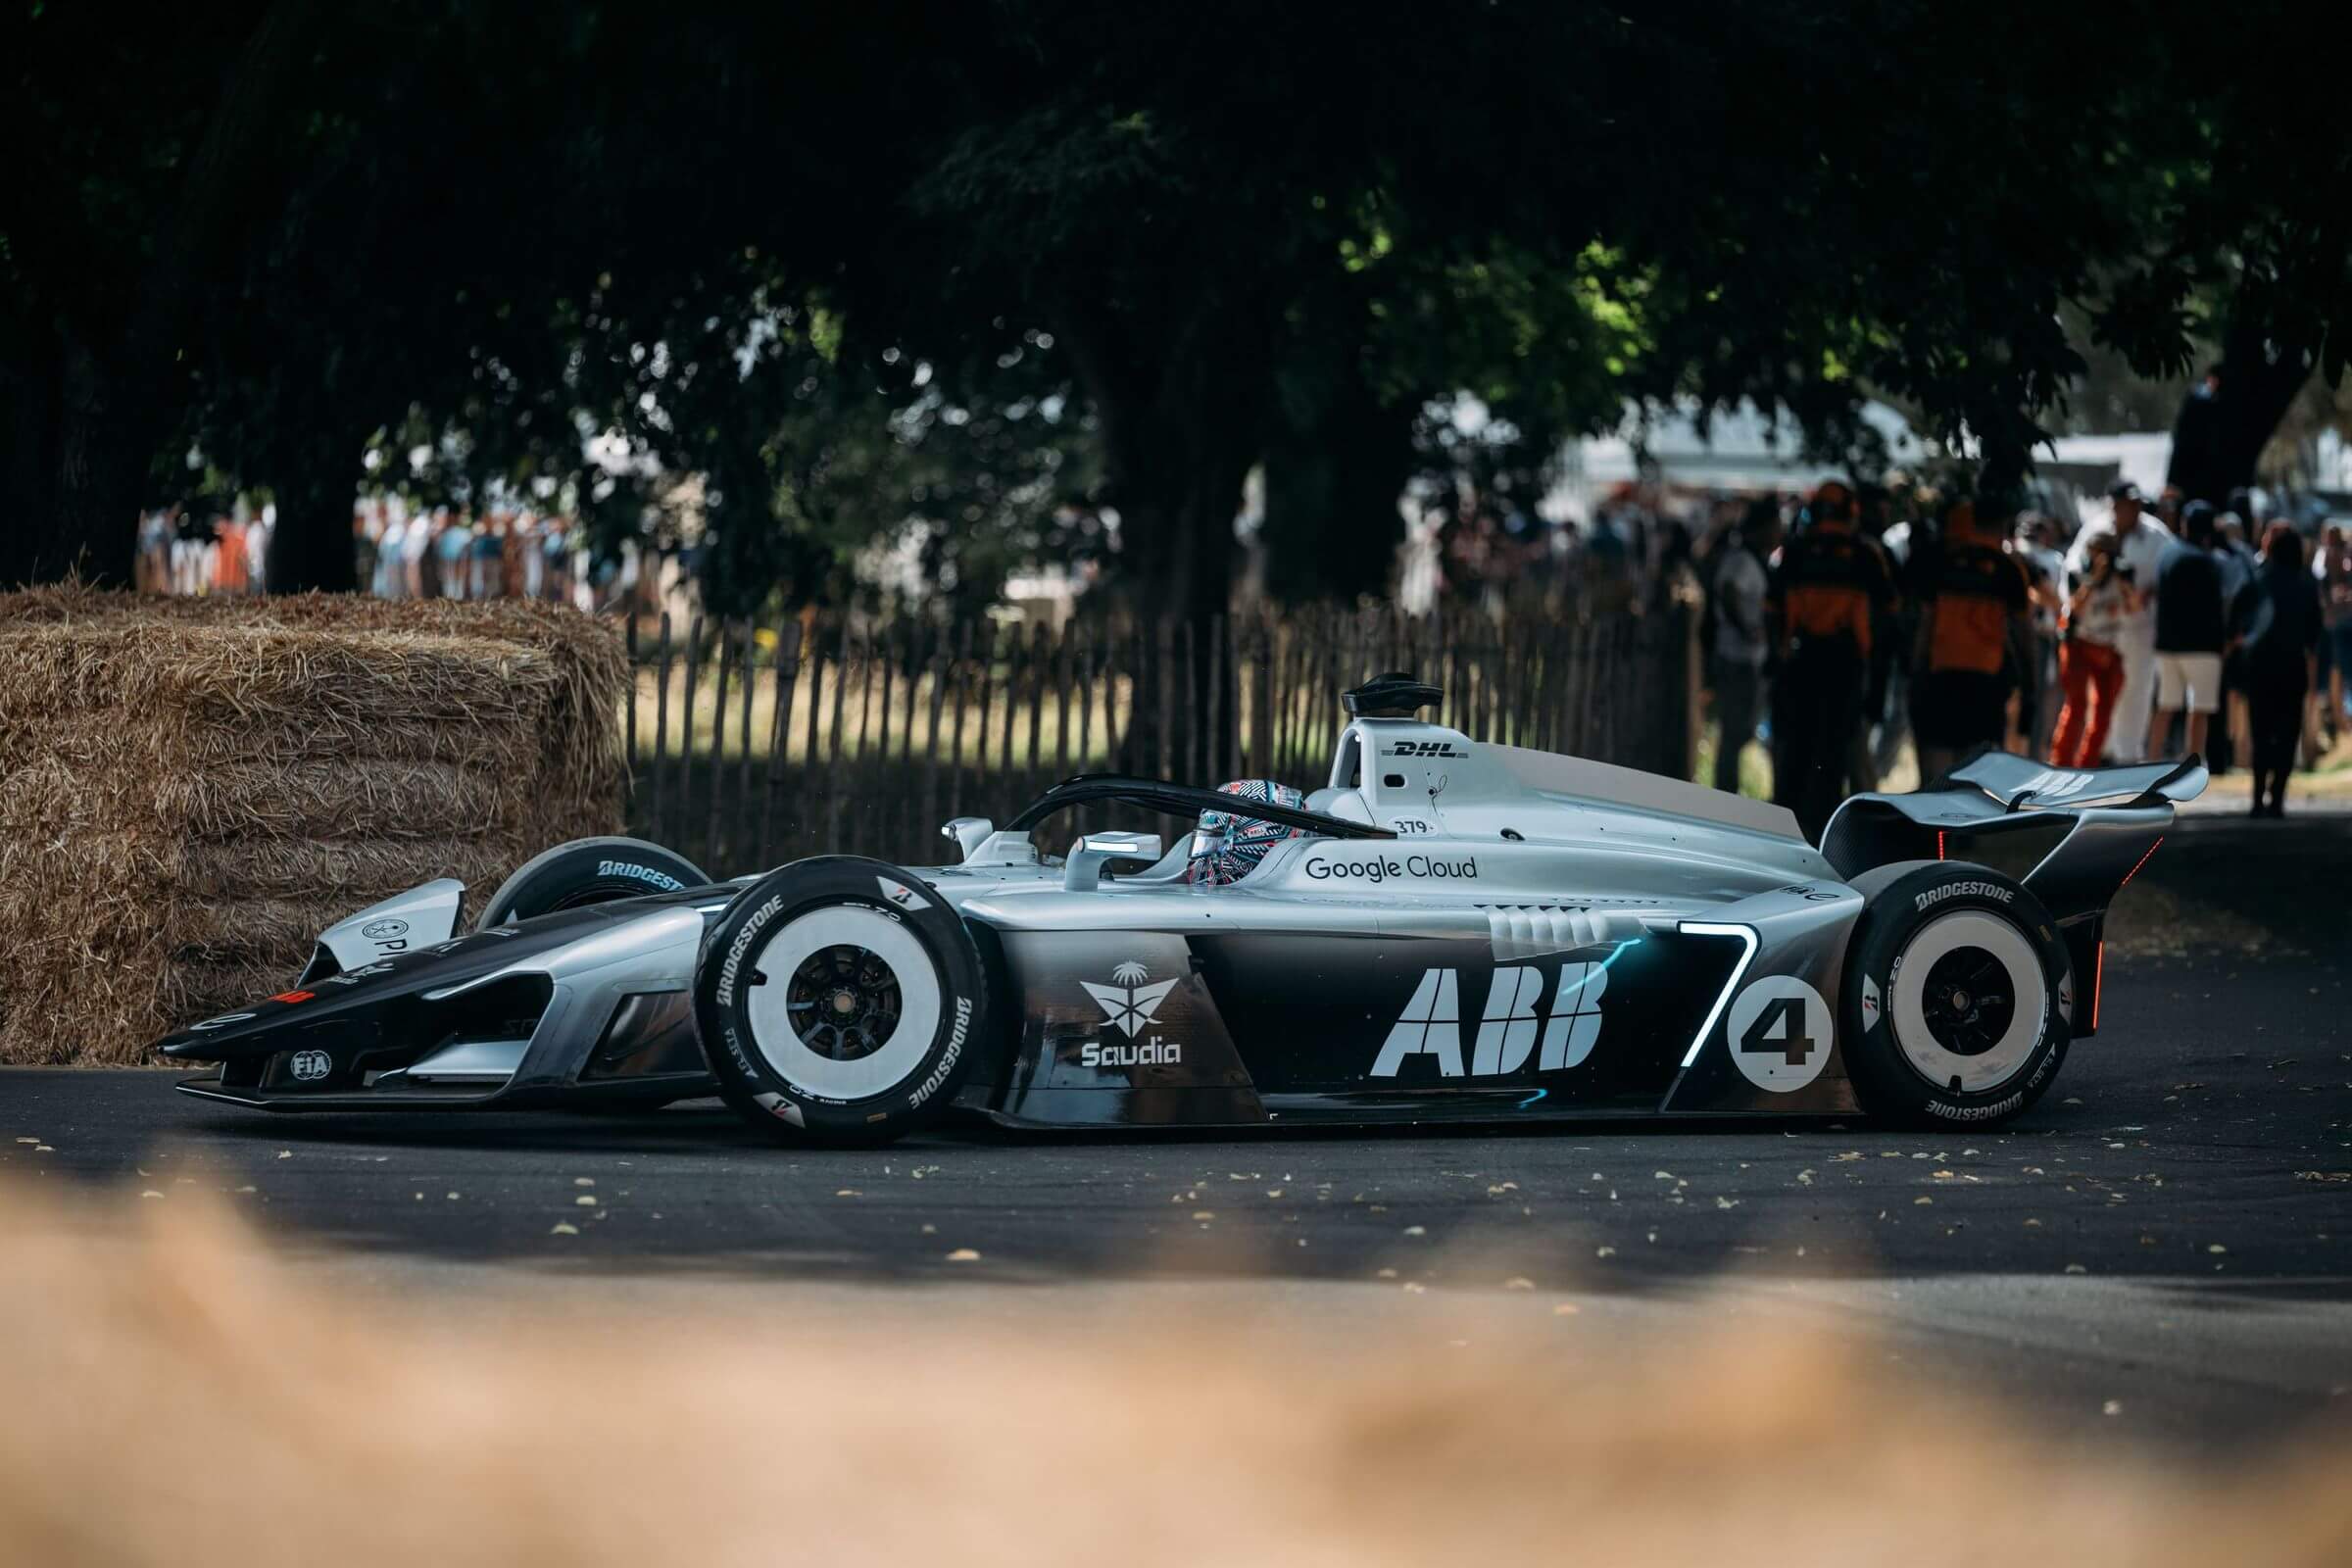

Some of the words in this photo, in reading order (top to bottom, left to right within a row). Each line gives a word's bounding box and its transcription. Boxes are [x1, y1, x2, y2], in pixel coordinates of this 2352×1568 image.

[1393, 742, 1457, 758] DHL
[1395, 821, 1428, 833] 379
[1306, 855, 1401, 883] Google
[1407, 856, 1478, 878] Cloud
[1915, 881, 2015, 911] BRIDGESTONE
[716, 894, 783, 1007] BRIDGESTONE
[1370, 961, 1609, 1077] ABB
[1740, 998, 1815, 1066] 4
[294, 1054, 330, 1075] FIA
[908, 996, 973, 1109] BRIDGESTONE
[1081, 1036, 1181, 1067] Saudia
[1925, 1091, 2024, 1121] BRIDGESTONE
